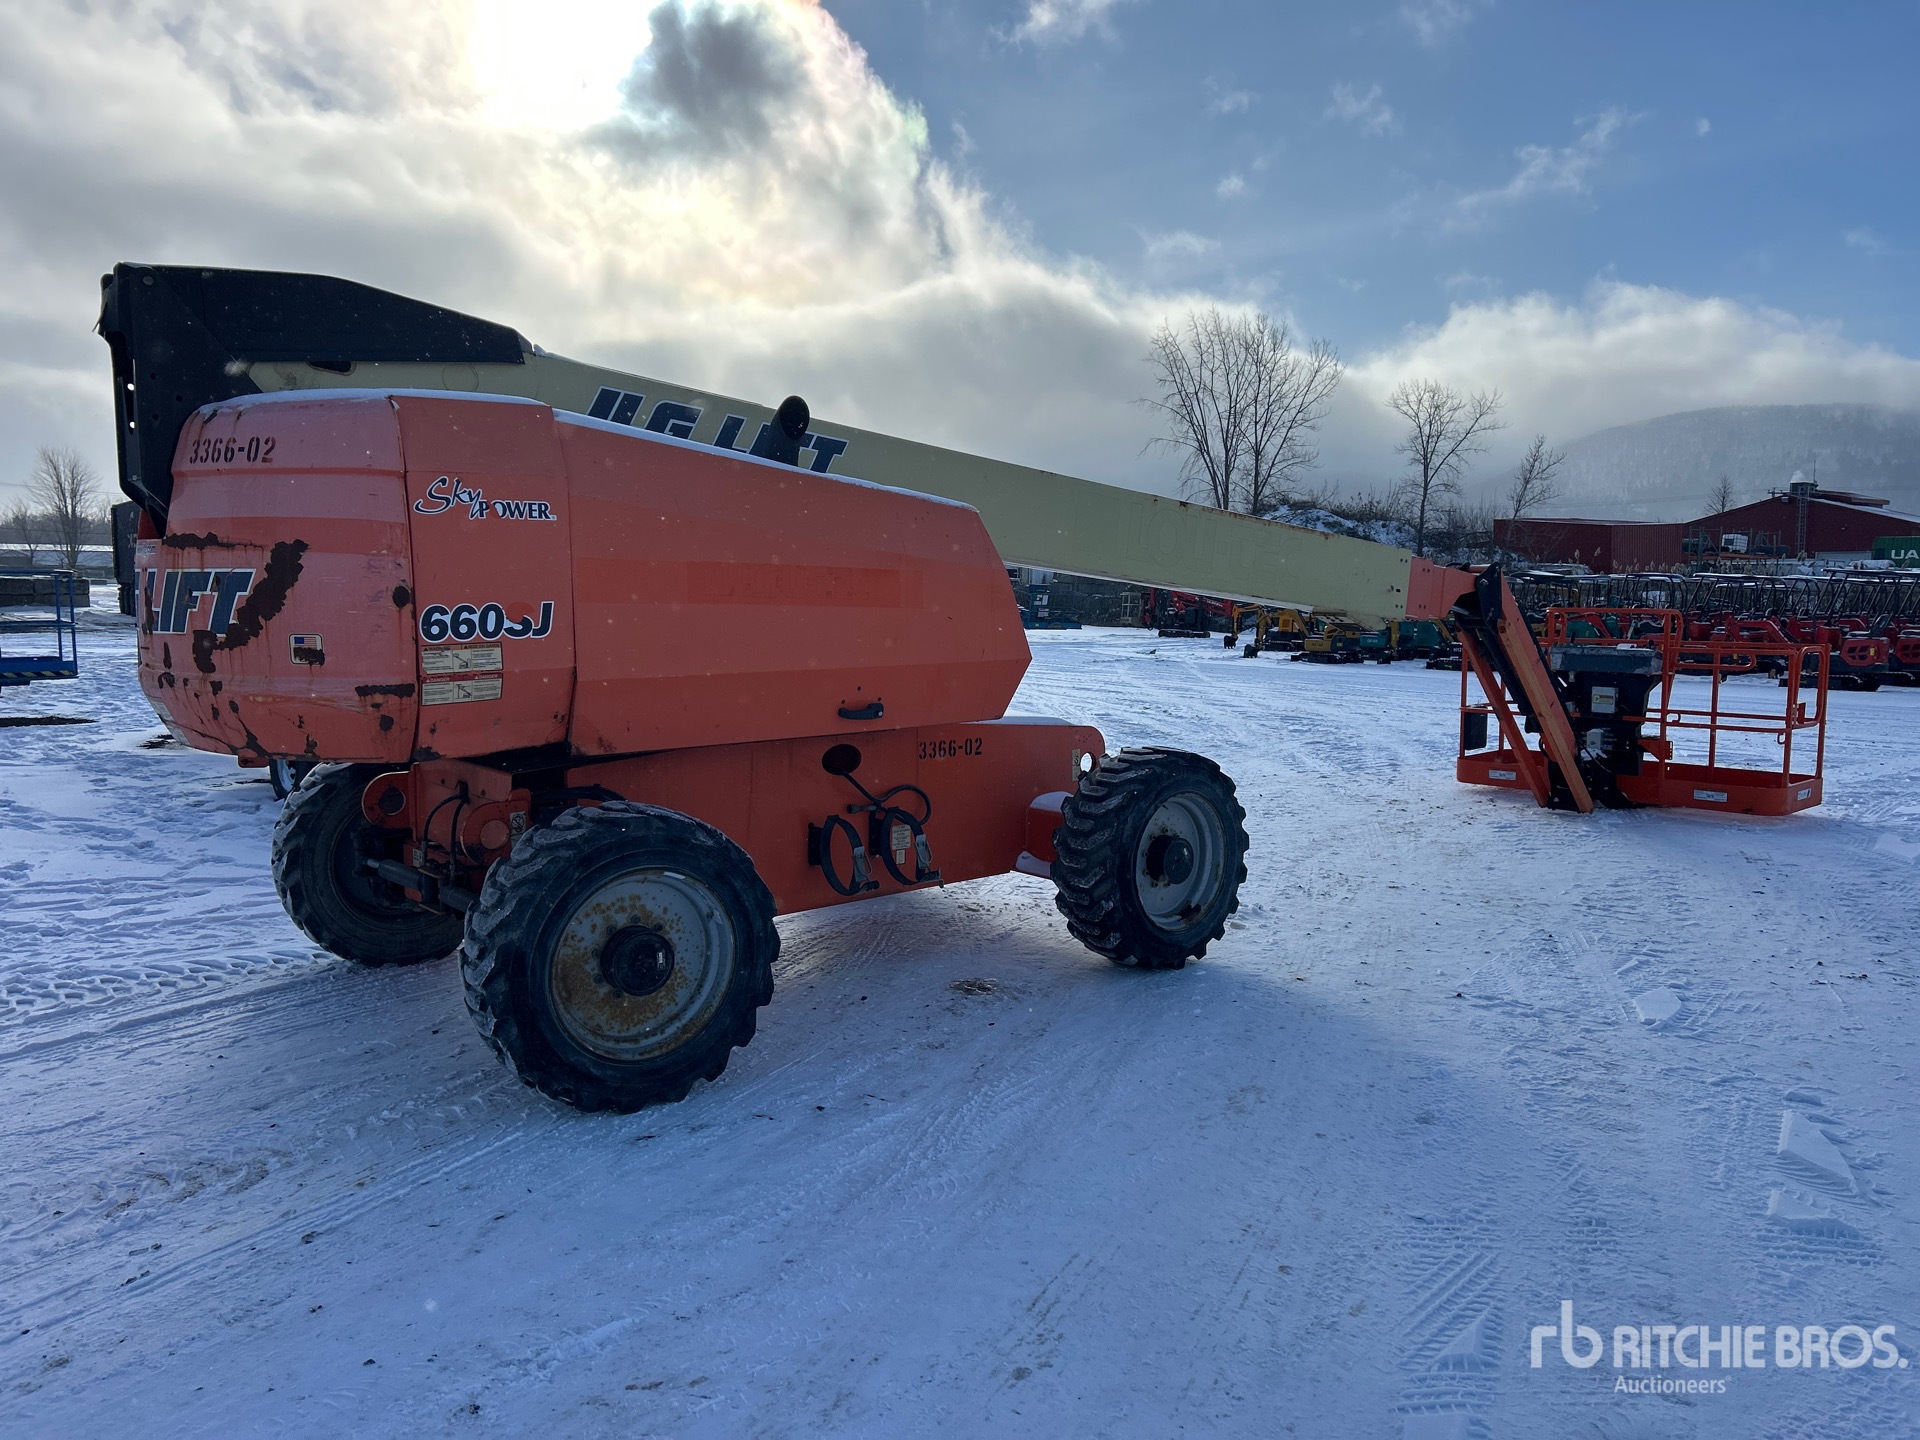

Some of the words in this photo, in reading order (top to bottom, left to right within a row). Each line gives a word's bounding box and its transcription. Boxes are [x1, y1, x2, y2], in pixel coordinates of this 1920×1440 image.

[189, 436, 276, 464] 3366-02
[712, 412, 850, 474] LIT
[918, 737, 983, 760] 3366-02
